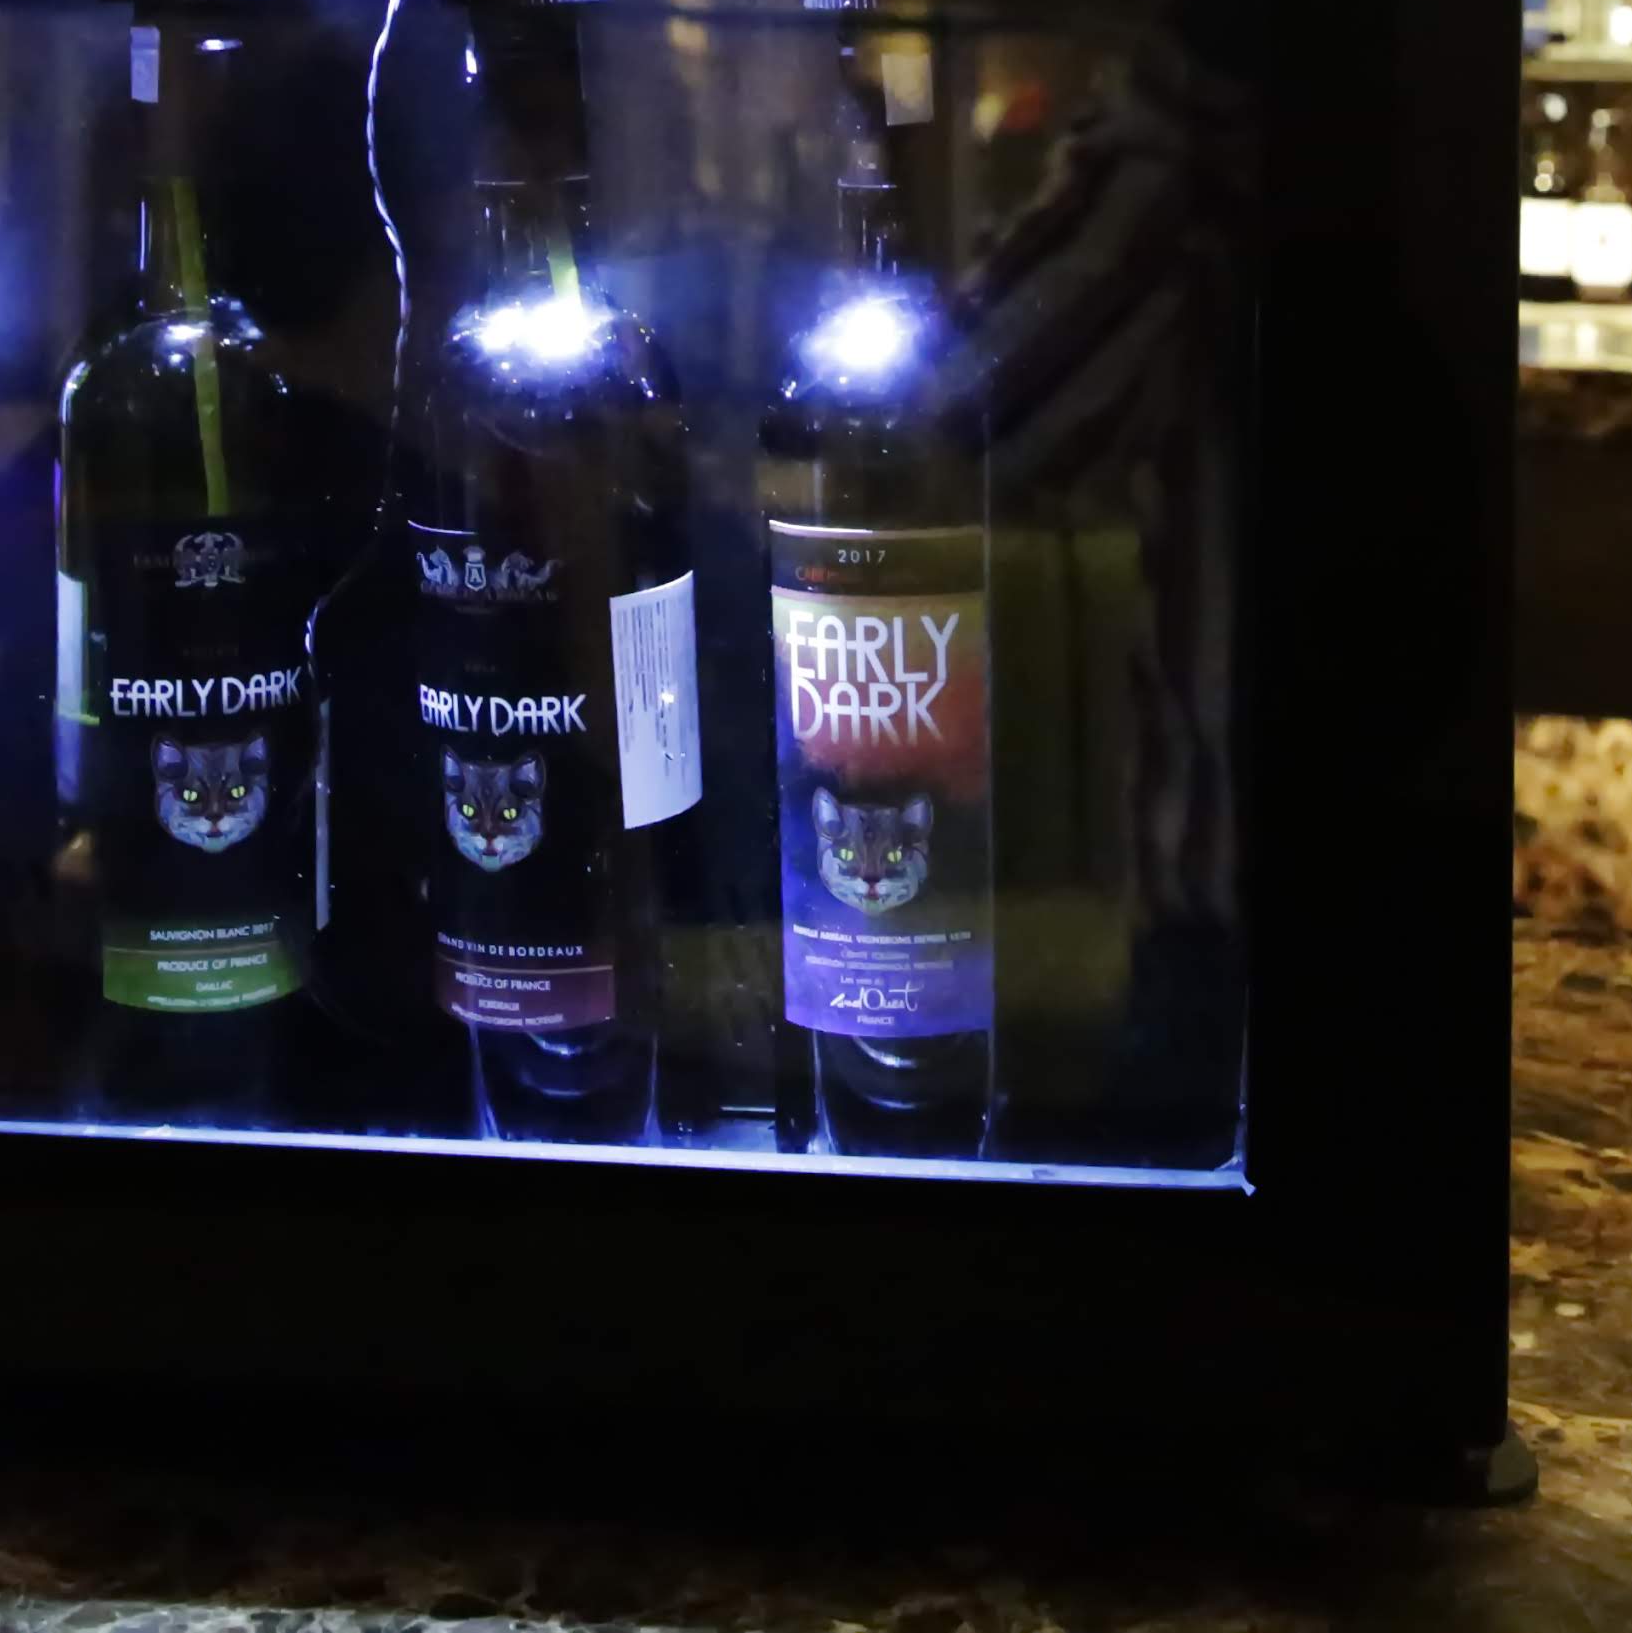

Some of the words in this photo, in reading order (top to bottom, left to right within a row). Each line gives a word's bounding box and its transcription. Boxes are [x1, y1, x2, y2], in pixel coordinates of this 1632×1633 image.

[838, 549, 886, 564] 2017
[785, 610, 959, 684] EARLY
[109, 677, 215, 718] EARLY
[220, 666, 302, 715] DARK
[419, 683, 484, 733] EARLY
[488, 693, 587, 736] DARK
[791, 674, 945, 748] DARK
[150, 929, 215, 942] SAUVIGNON
[216, 925, 250, 939] BLANC
[467, 942, 486, 954] VIN
[488, 945, 505, 956] DE
[508, 945, 584, 957] BORDEAUX
[157, 959, 208, 973] PRODUCE
[212, 958, 227, 970] OF
[229, 953, 268, 968] FRANCE
[494, 979, 509, 990] OF
[510, 980, 551, 992] FRANCE
